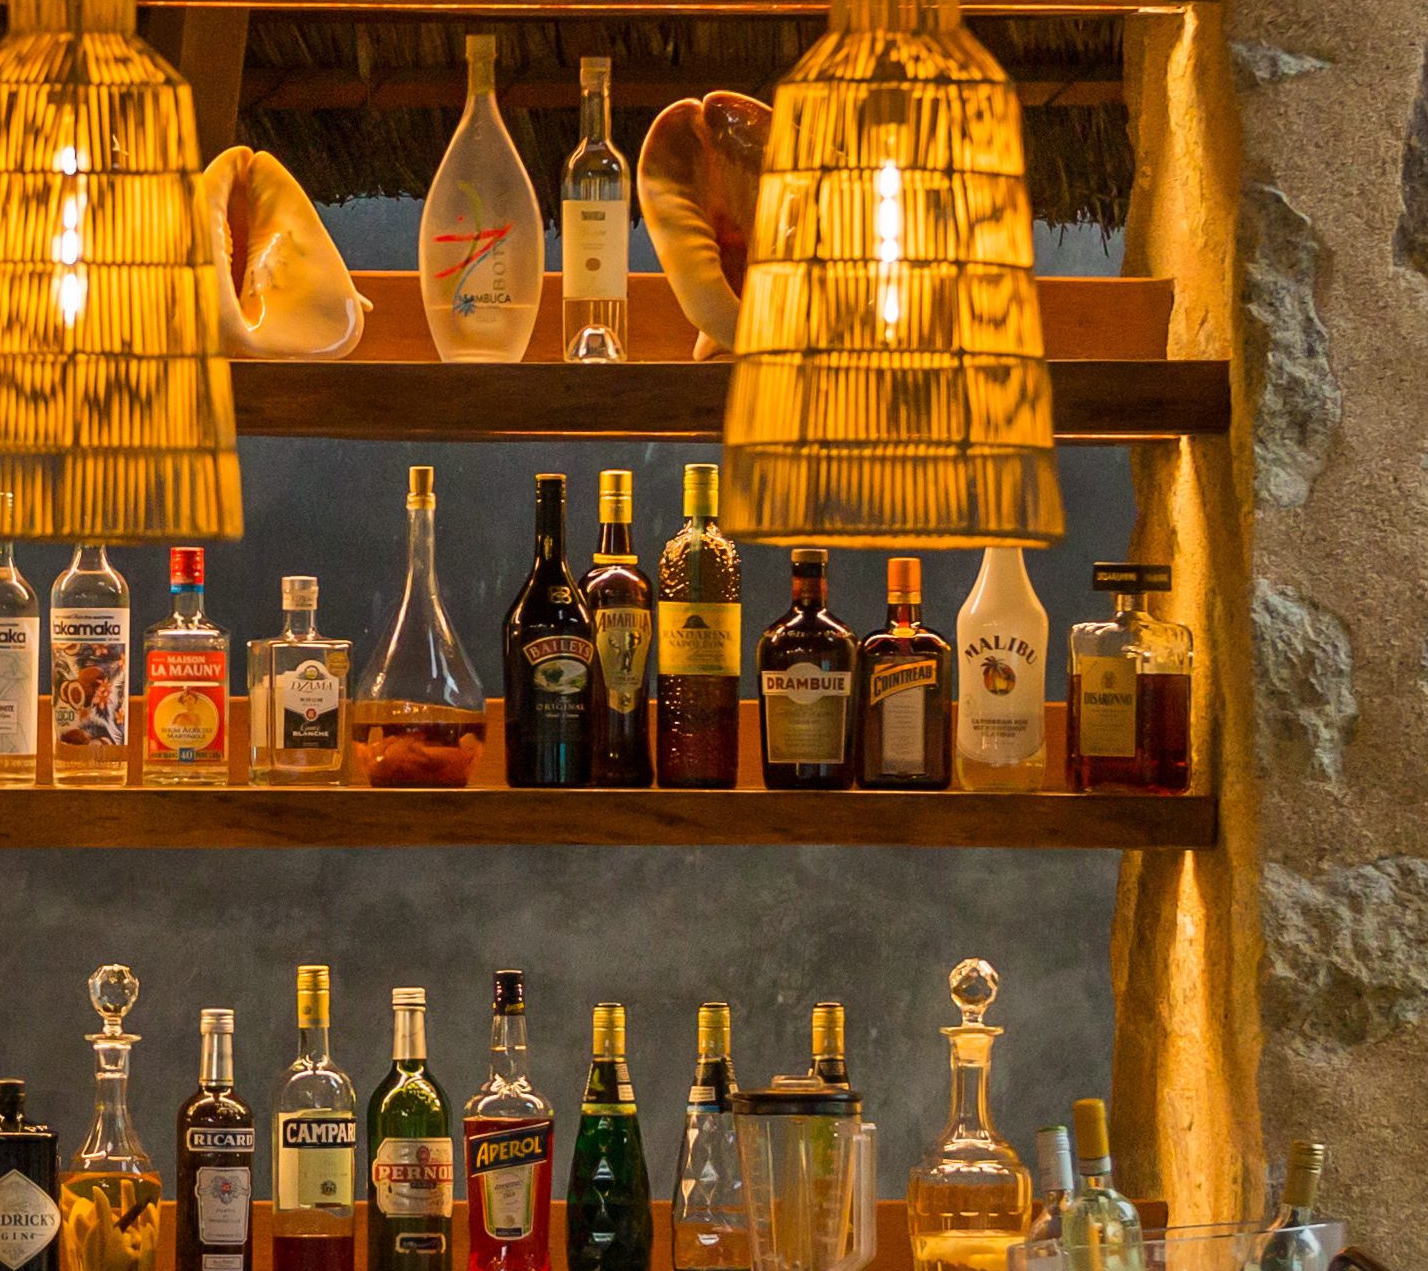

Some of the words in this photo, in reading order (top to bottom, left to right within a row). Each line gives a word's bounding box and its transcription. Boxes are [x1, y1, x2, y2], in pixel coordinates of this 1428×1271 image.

[53, 620, 121, 636] akamaka
[598, 612, 649, 634] AMARULA
[529, 640, 591, 659] BAILEYS
[964, 634, 1039, 665] MALIBU
[166, 655, 207, 664] MAISON
[151, 664, 167, 677] LA
[169, 664, 222, 677] MAUNY
[766, 677, 845, 691] DRAMBUIE
[873, 664, 933, 697] COINTREAU
[193, 1133, 253, 1146] RICARD
[476, 1136, 542, 1168] APEROL
[0, 1232, 29, 1240] GIN
